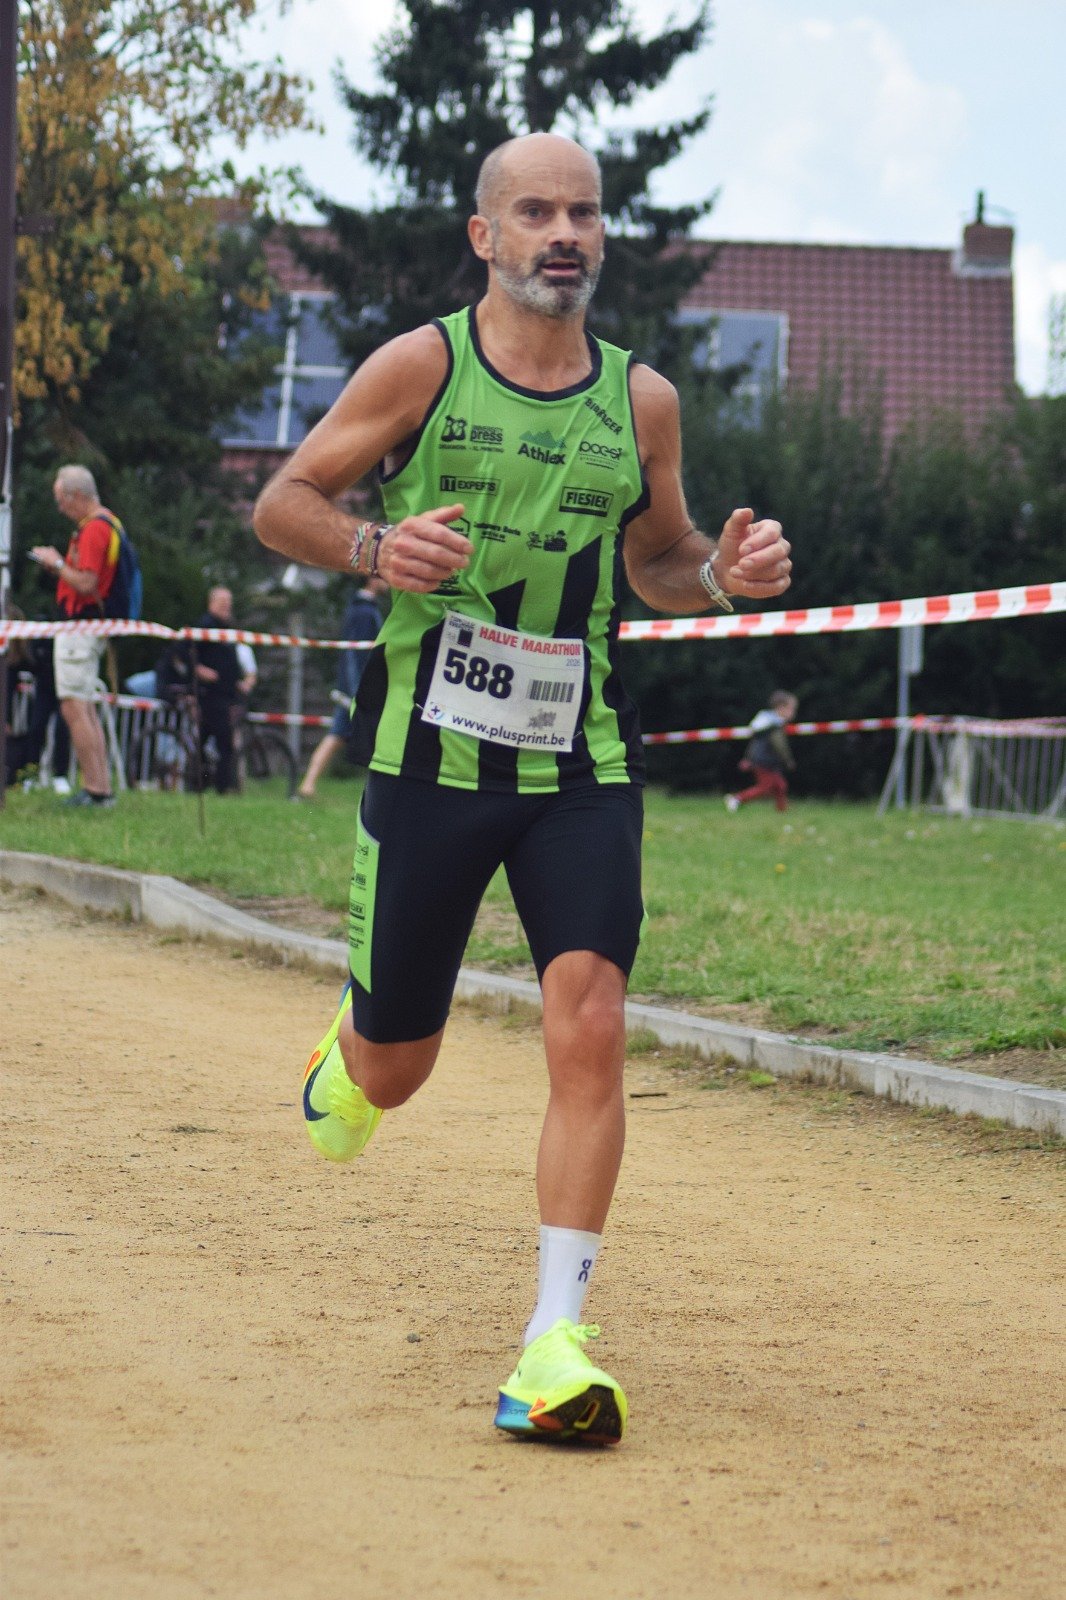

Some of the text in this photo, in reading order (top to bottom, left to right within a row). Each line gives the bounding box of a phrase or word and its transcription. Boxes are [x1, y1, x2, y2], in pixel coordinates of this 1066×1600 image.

[471, 429, 503, 442] press
[517, 443, 566, 465] Athlex
[479, 626, 581, 656] HALVE MARATHON
[443, 648, 514, 699] 588
[452, 714, 565, 745] www.plusprint.be
